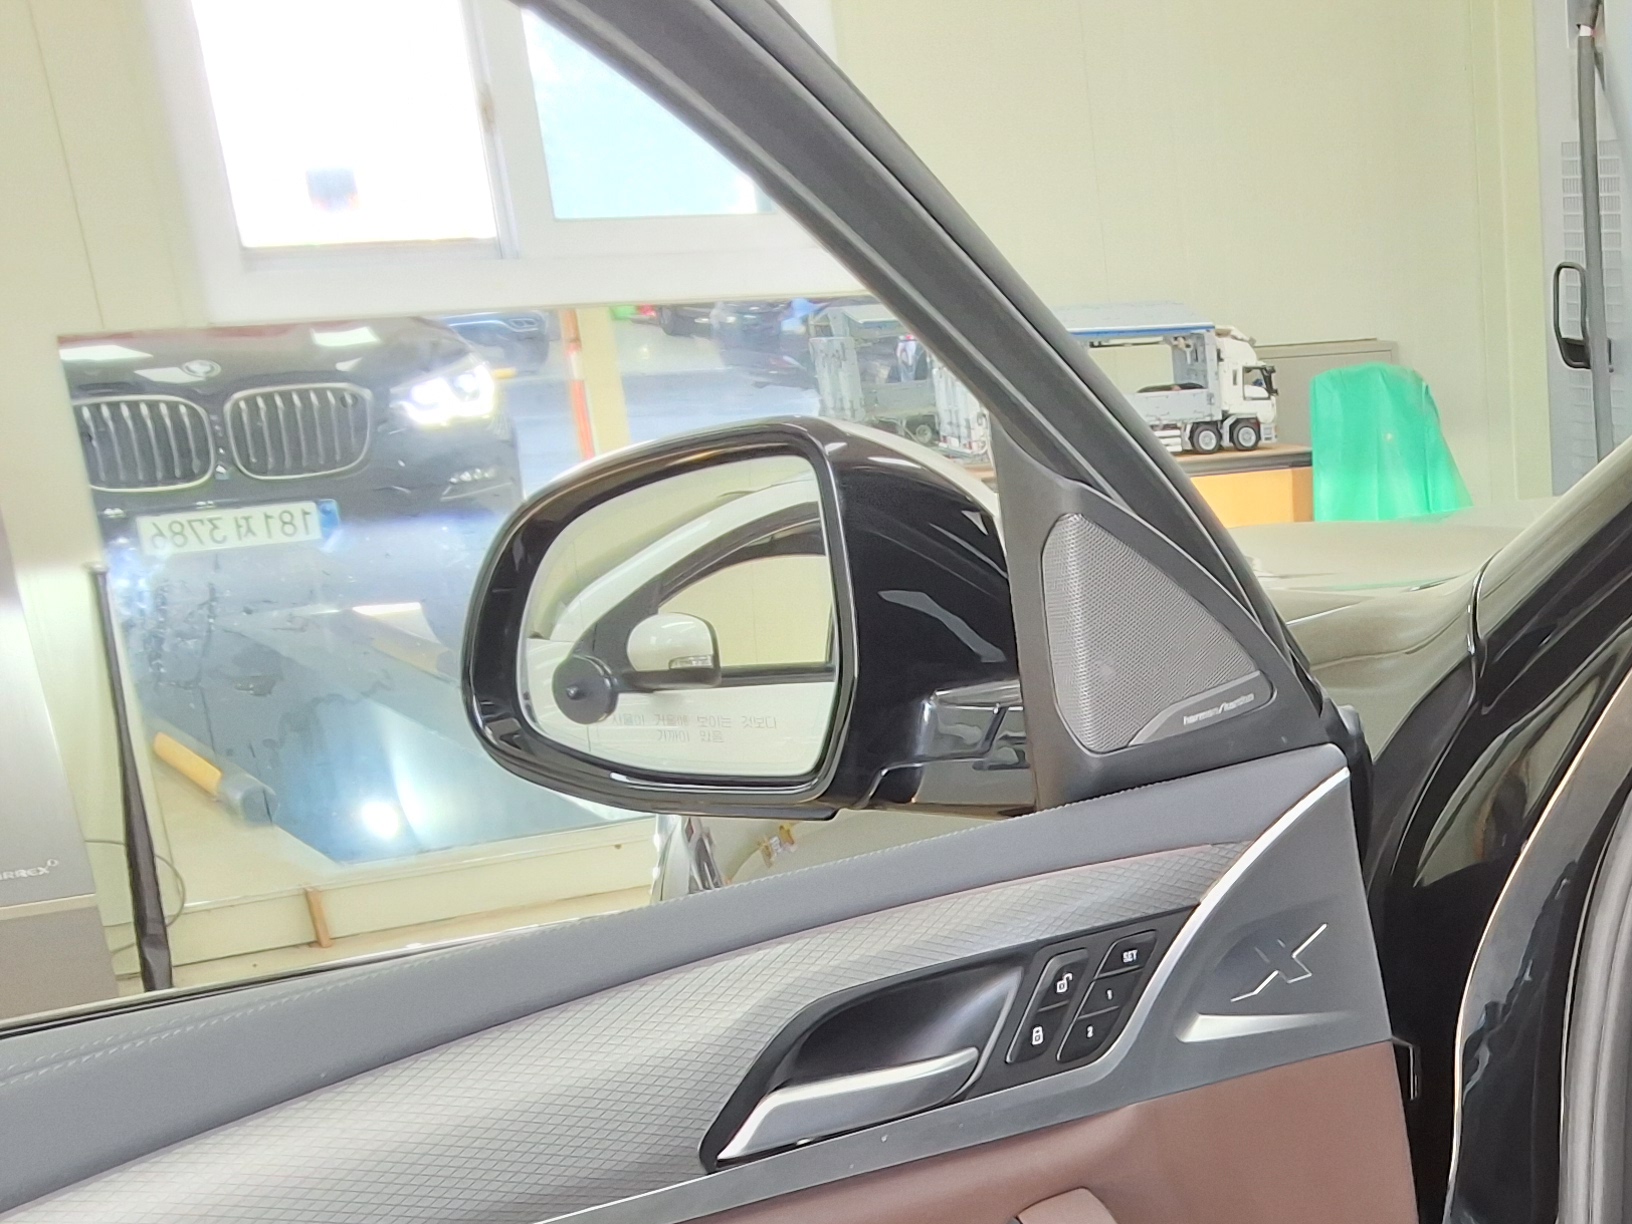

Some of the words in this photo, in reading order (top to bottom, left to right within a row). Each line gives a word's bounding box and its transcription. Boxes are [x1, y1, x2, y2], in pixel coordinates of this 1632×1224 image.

[696, 715, 731, 729] 보이는
[1122, 949, 1138, 963] SET
[1107, 990, 1113, 1000] 1
[1087, 1026, 1094, 1038] 2
